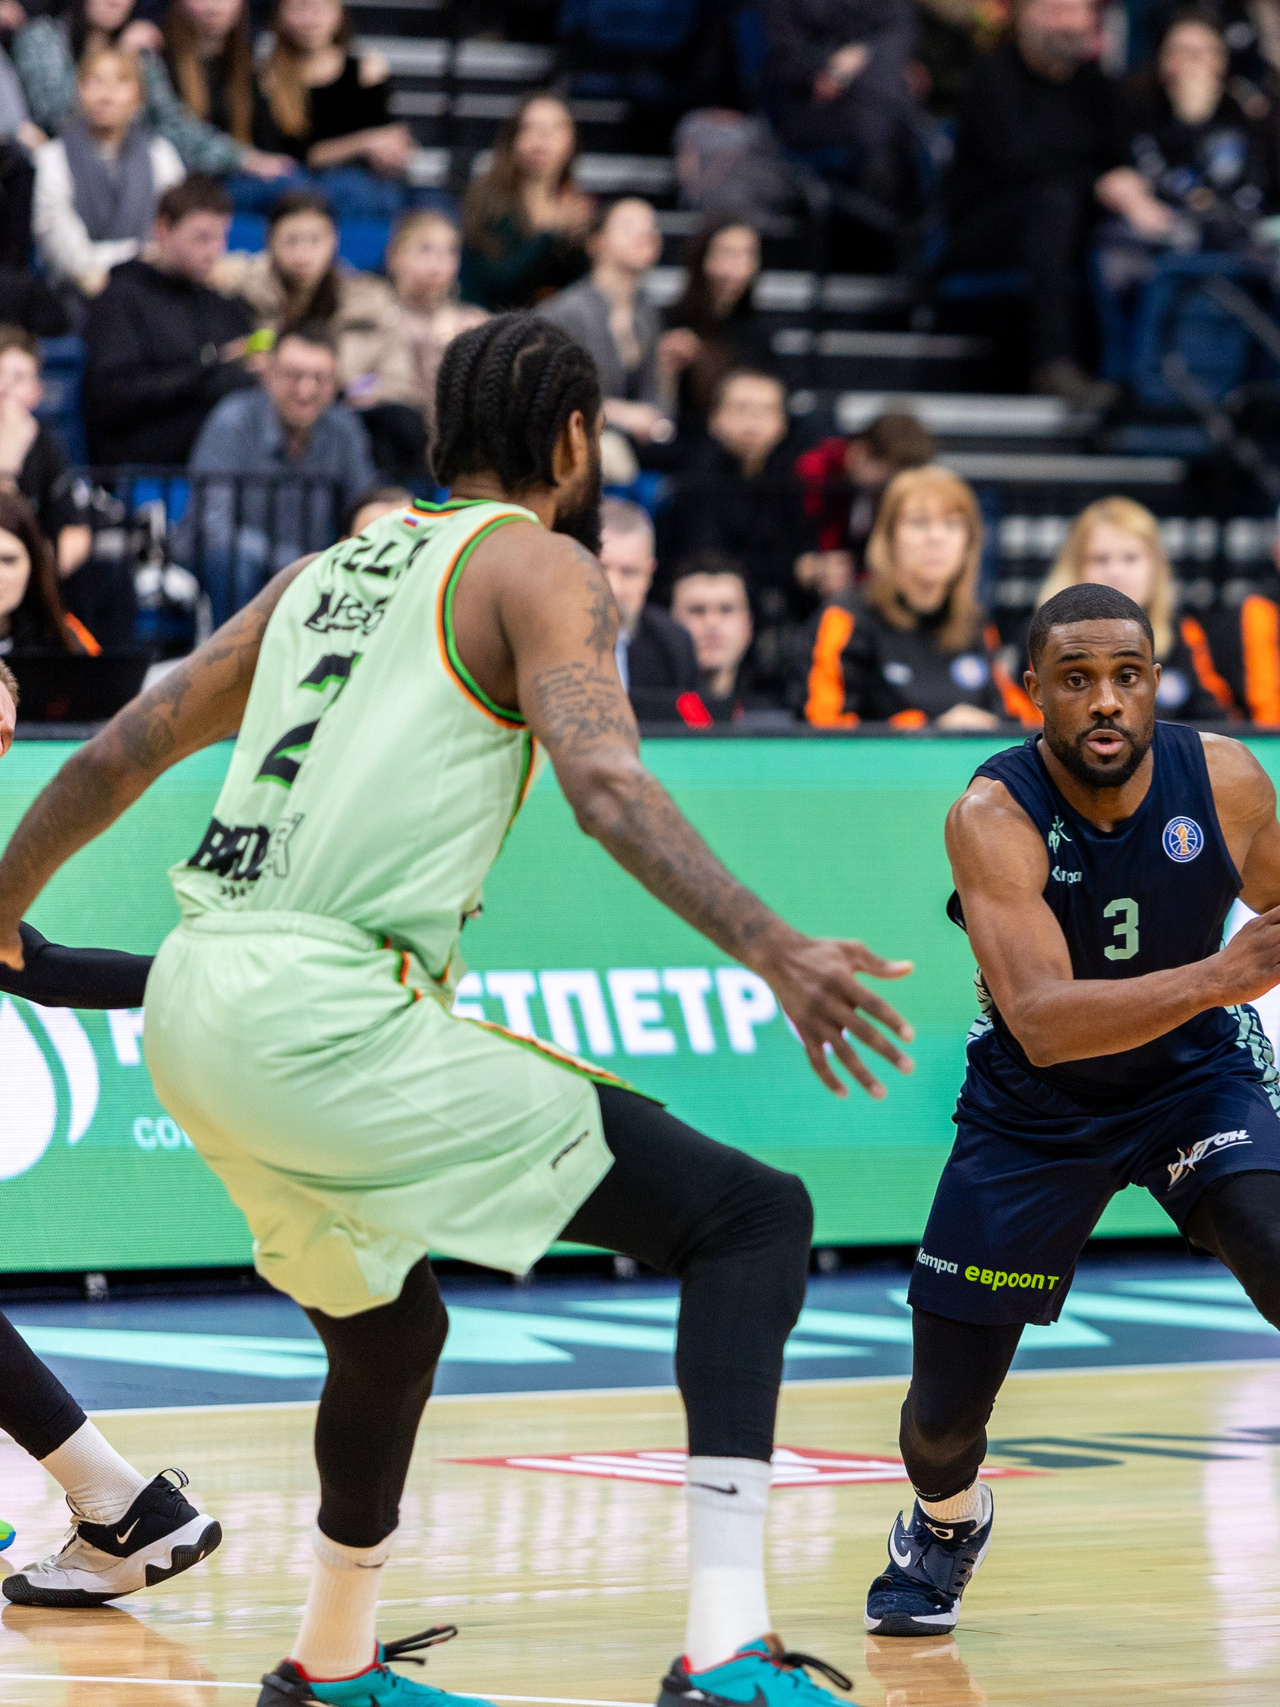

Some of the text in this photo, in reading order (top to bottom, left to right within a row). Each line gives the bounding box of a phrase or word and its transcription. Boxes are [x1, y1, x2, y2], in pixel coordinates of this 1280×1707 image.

[1103, 897, 1139, 961] 3
[916, 1247, 959, 1275] Kempa
[964, 1265, 1060, 1292] евроопт
